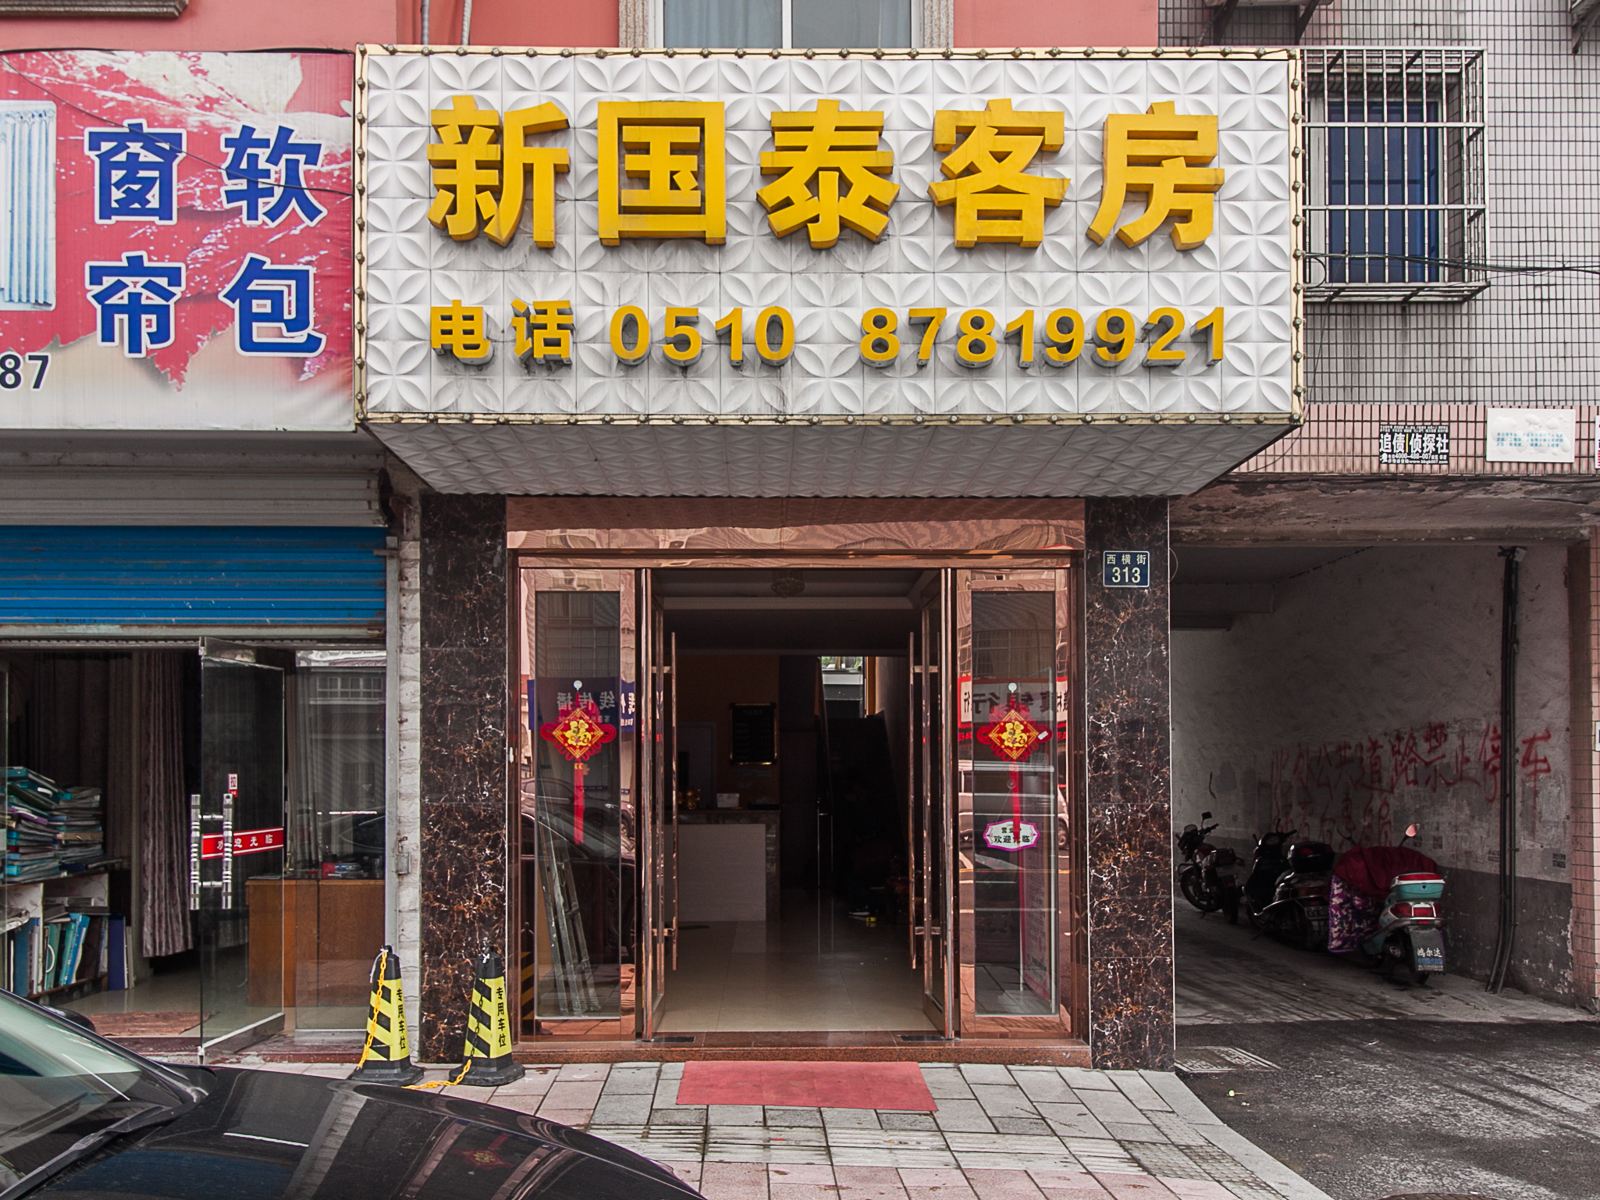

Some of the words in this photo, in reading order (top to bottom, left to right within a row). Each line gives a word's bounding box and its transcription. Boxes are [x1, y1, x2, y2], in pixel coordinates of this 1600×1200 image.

[427, 95, 1225, 252] 新国泰客房
[86, 122, 184, 356] 窗帘
[222, 123, 326, 355] 软包
[430, 298, 574, 365] 电话
[609, 303, 795, 366] 0510
[860, 304, 1225, 367] 87819921
[0, 354, 49, 389] 87
[1106, 554, 1147, 565] 西横街
[1111, 566, 1141, 583] 313
[396, 988, 406, 1050] 专用车位
[496, 987, 507, 1048] 专用车位
